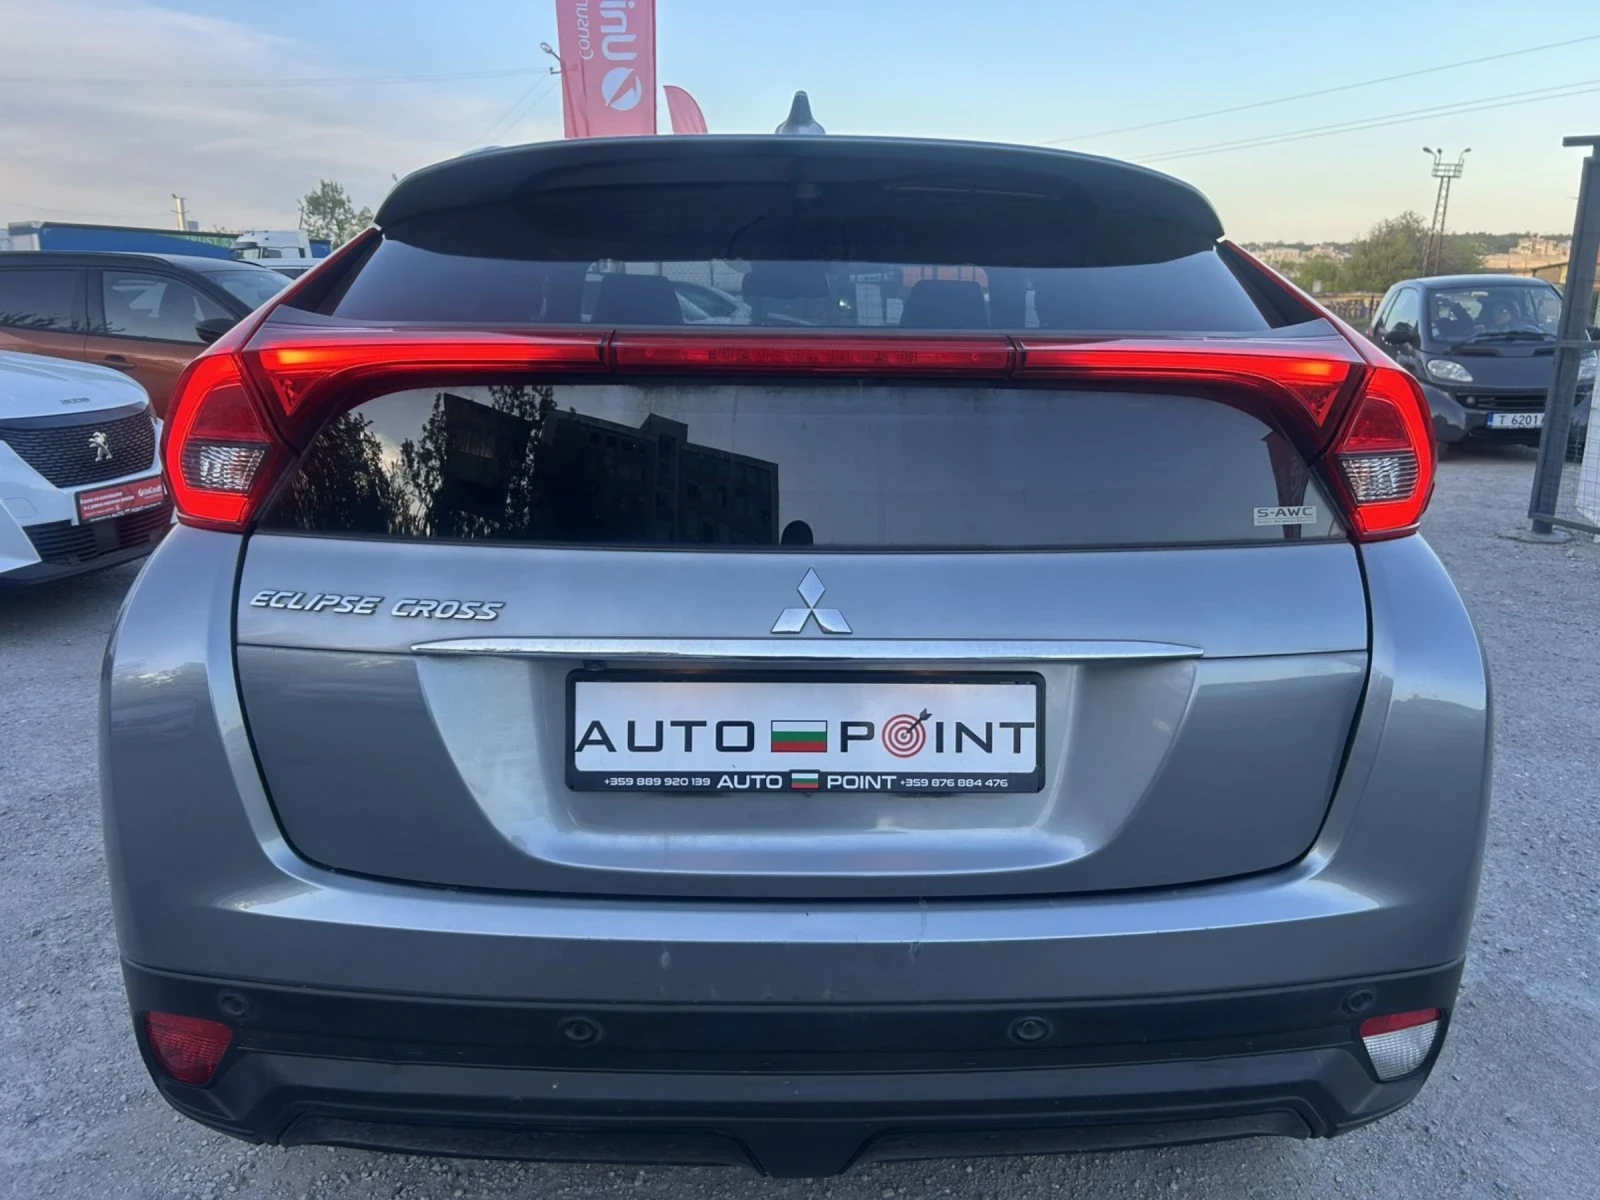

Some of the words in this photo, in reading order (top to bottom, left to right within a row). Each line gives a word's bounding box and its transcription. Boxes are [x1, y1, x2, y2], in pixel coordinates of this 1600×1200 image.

[1499, 415, 1506, 425] T
[1511, 415, 1537, 425] 6201
[1257, 507, 1313, 517] S-AWC
[249, 590, 385, 615] ECLIPSE
[391, 598, 505, 621] CROSS
[574, 720, 755, 753] AUTO
[604, 777, 633, 786] +359
[636, 777, 662, 786] 889
[664, 777, 689, 786] 920
[691, 777, 711, 786] 139
[717, 774, 783, 789] AUTO
[827, 775, 897, 789] POINT
[900, 778, 929, 787] +359
[931, 778, 956, 788] 876
[957, 778, 982, 788] 884
[984, 778, 1009, 788] 476
